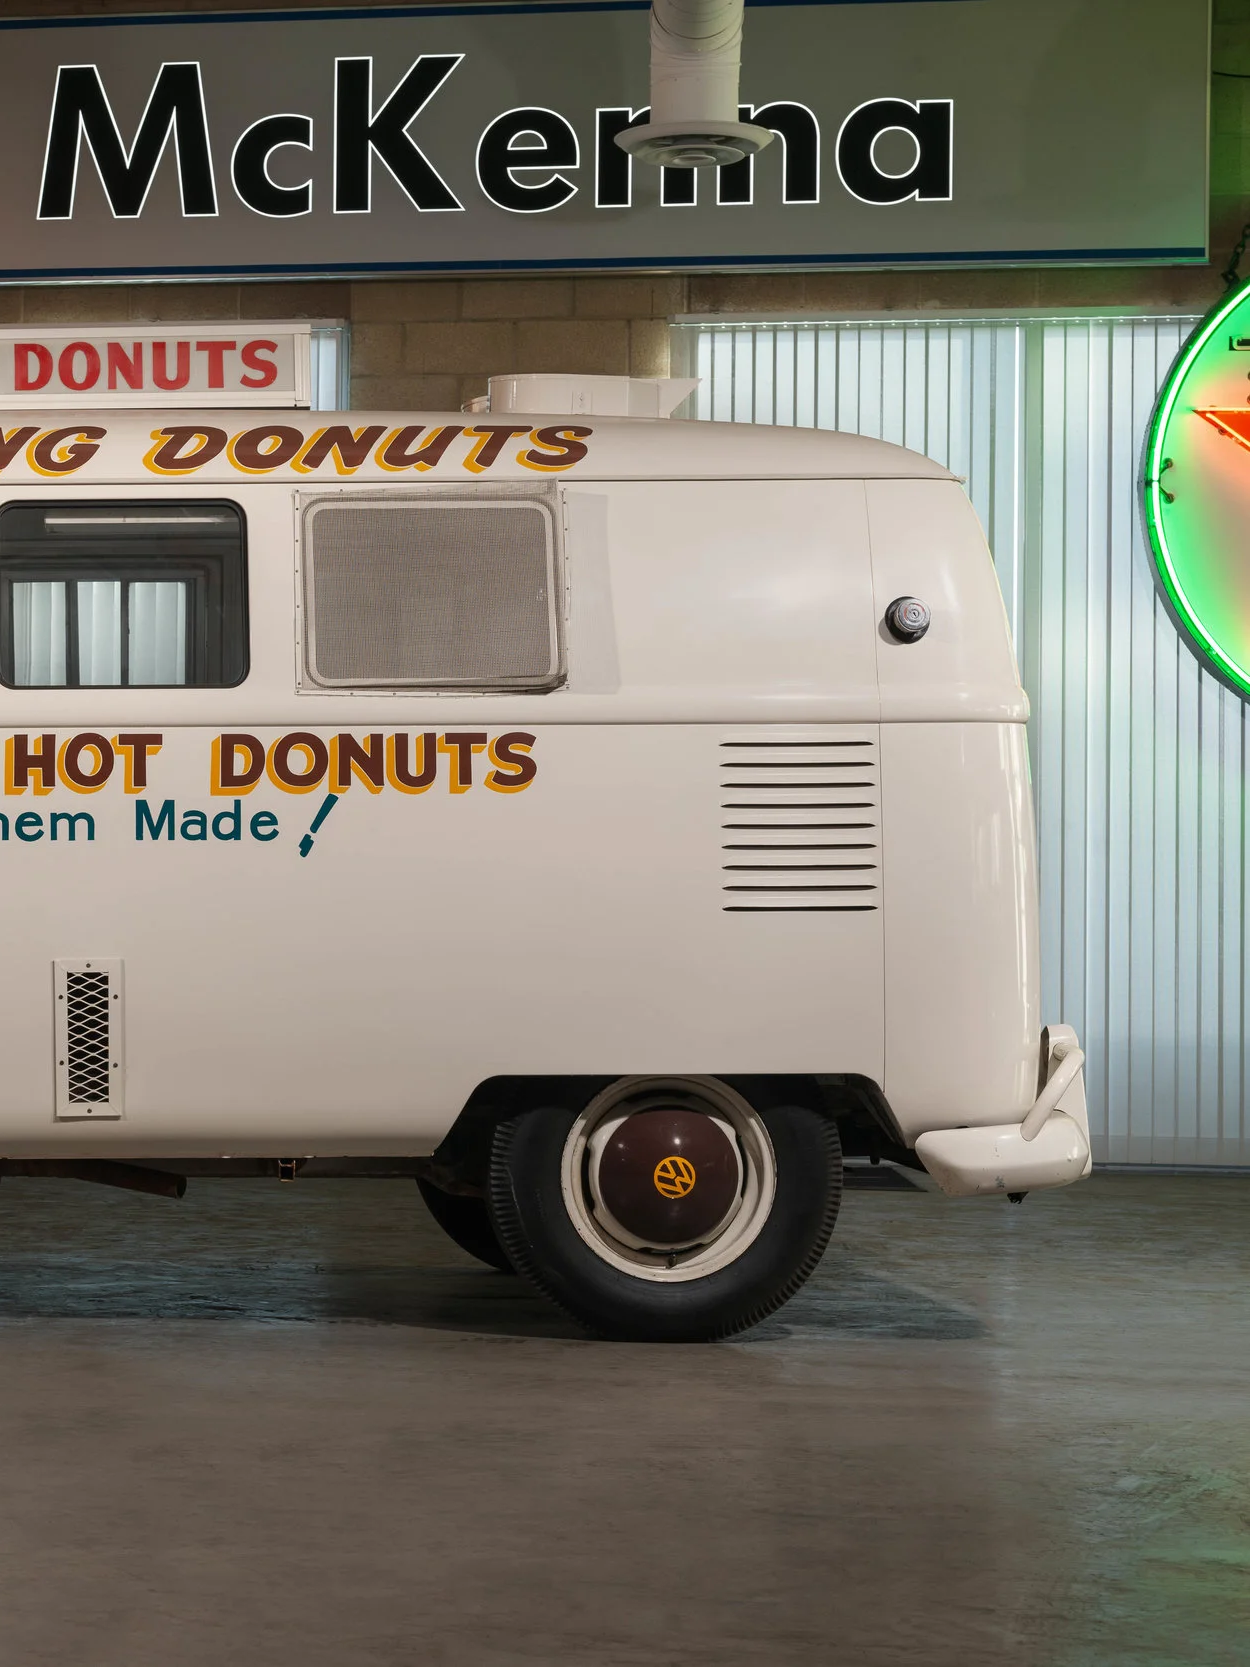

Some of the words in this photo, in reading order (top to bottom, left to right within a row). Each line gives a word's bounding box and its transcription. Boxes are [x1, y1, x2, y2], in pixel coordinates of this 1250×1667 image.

[36, 53, 954, 220] McKenna
[14, 340, 278, 391] DONUTS
[143, 424, 593, 475] DONUTS
[4, 733, 163, 796] HOT
[210, 732, 538, 796] DONUTS
